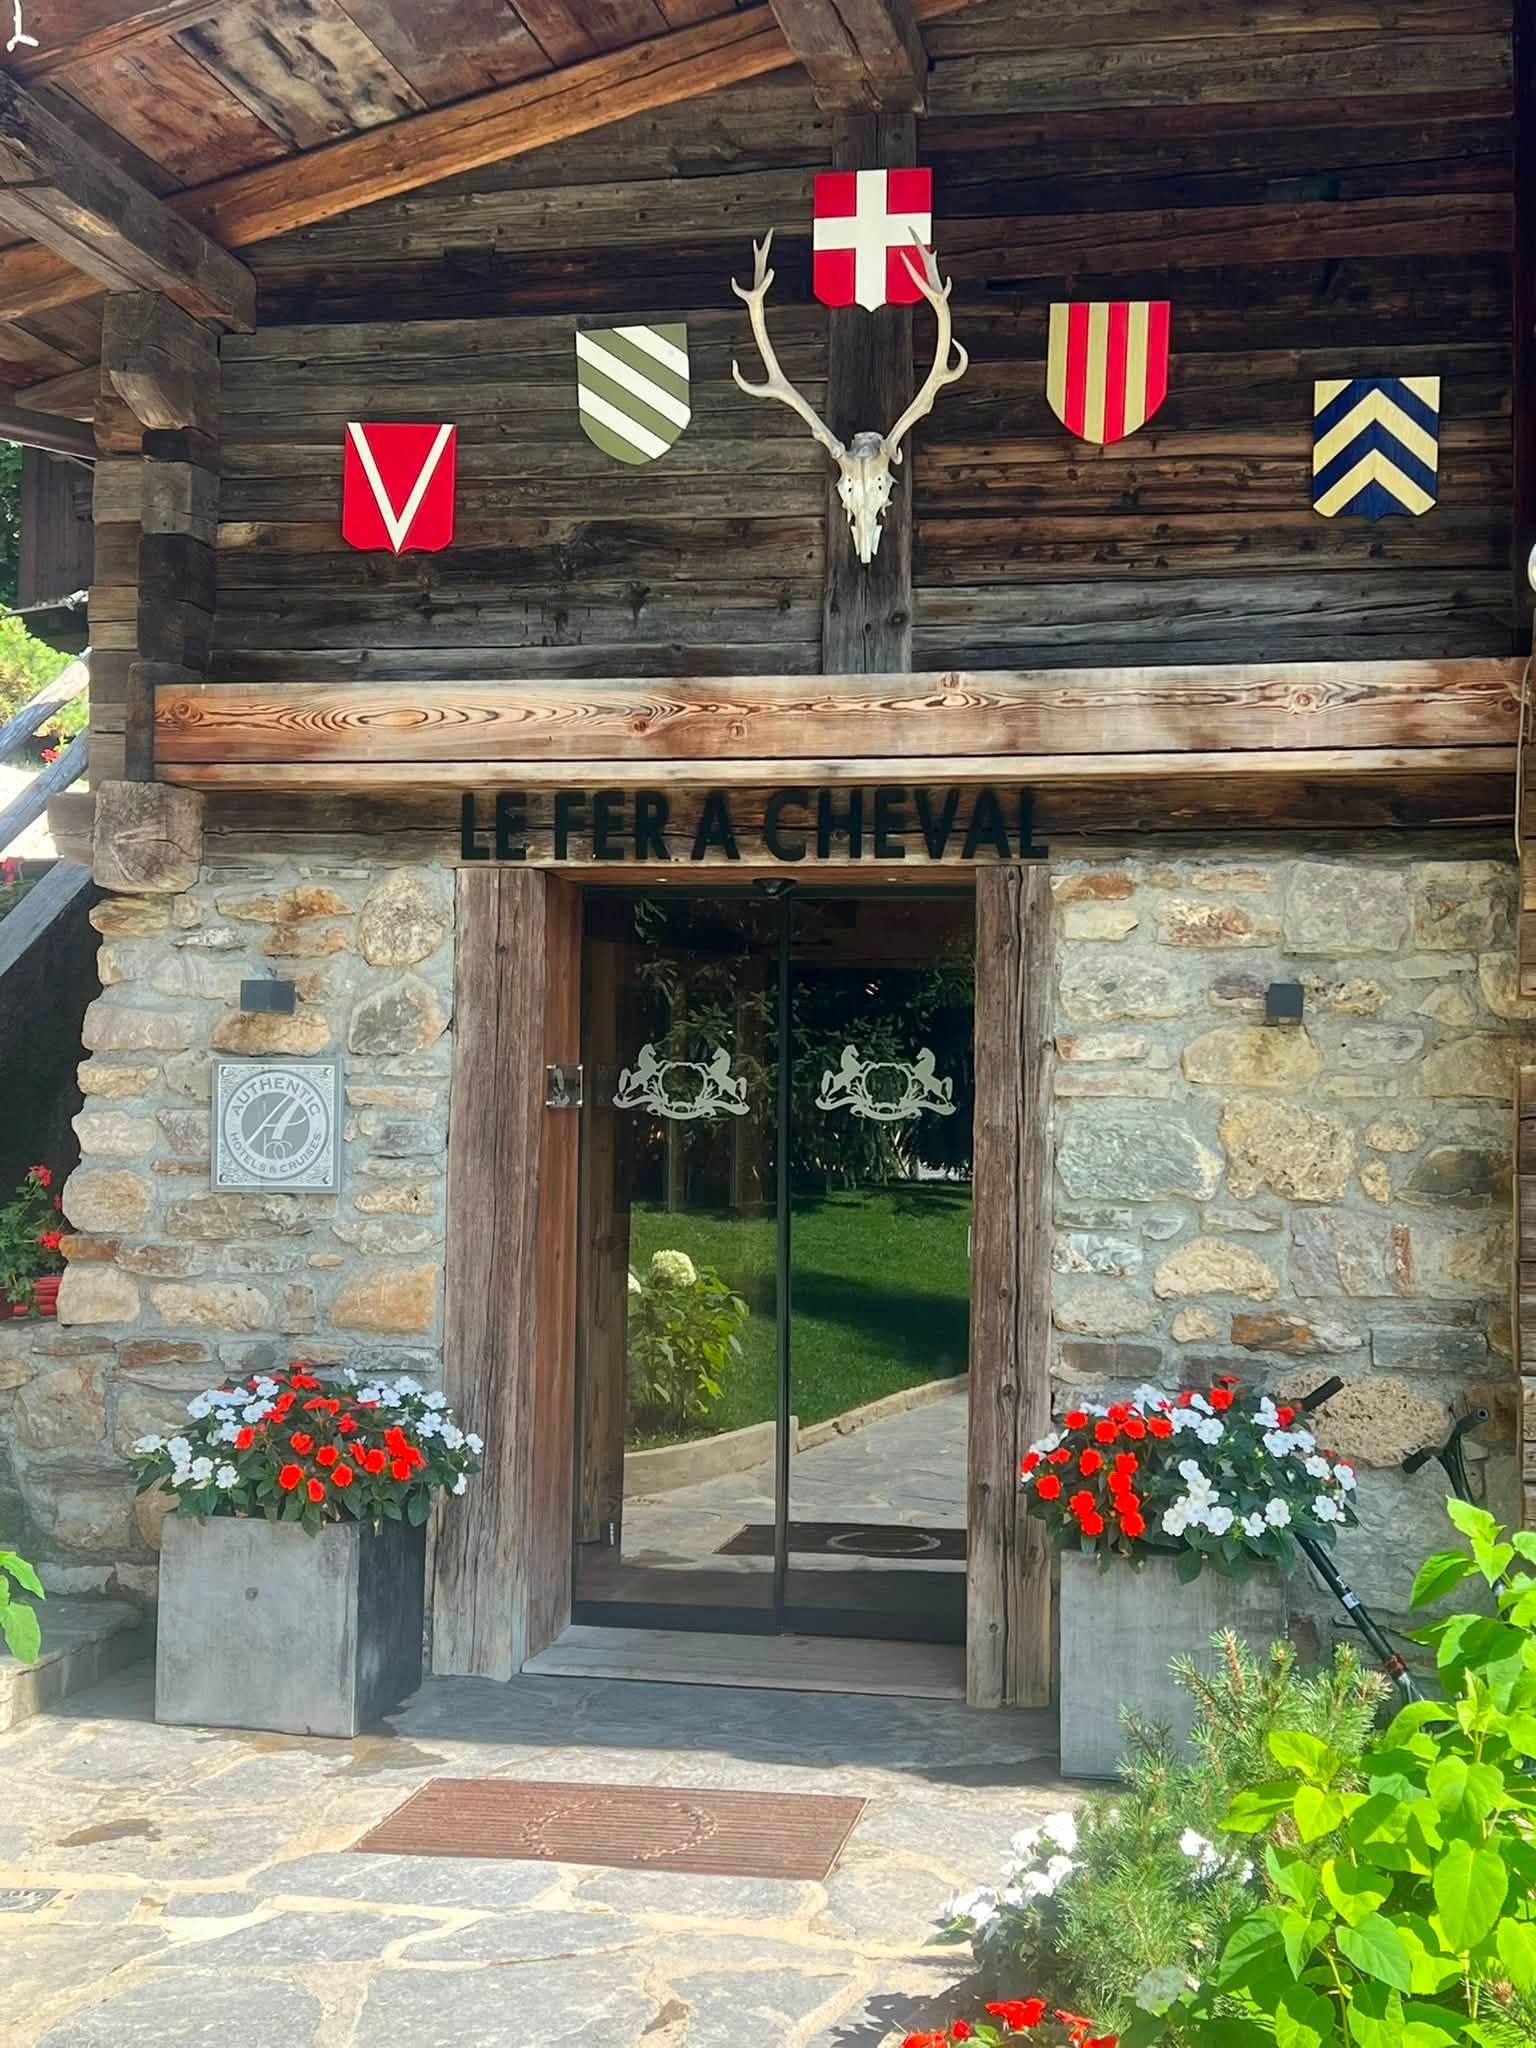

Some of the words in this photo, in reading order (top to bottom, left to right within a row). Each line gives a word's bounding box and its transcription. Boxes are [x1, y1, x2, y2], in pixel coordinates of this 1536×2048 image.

[460, 790, 529, 861] LE
[554, 790, 671, 861] FER
[691, 790, 740, 861] A
[764, 788, 1050, 862] CHEVAL
[231, 1077, 321, 1117] AUTHENTIC
[230, 1131, 267, 1173] HOTELS
[280, 1133, 322, 1174] CRUISES
